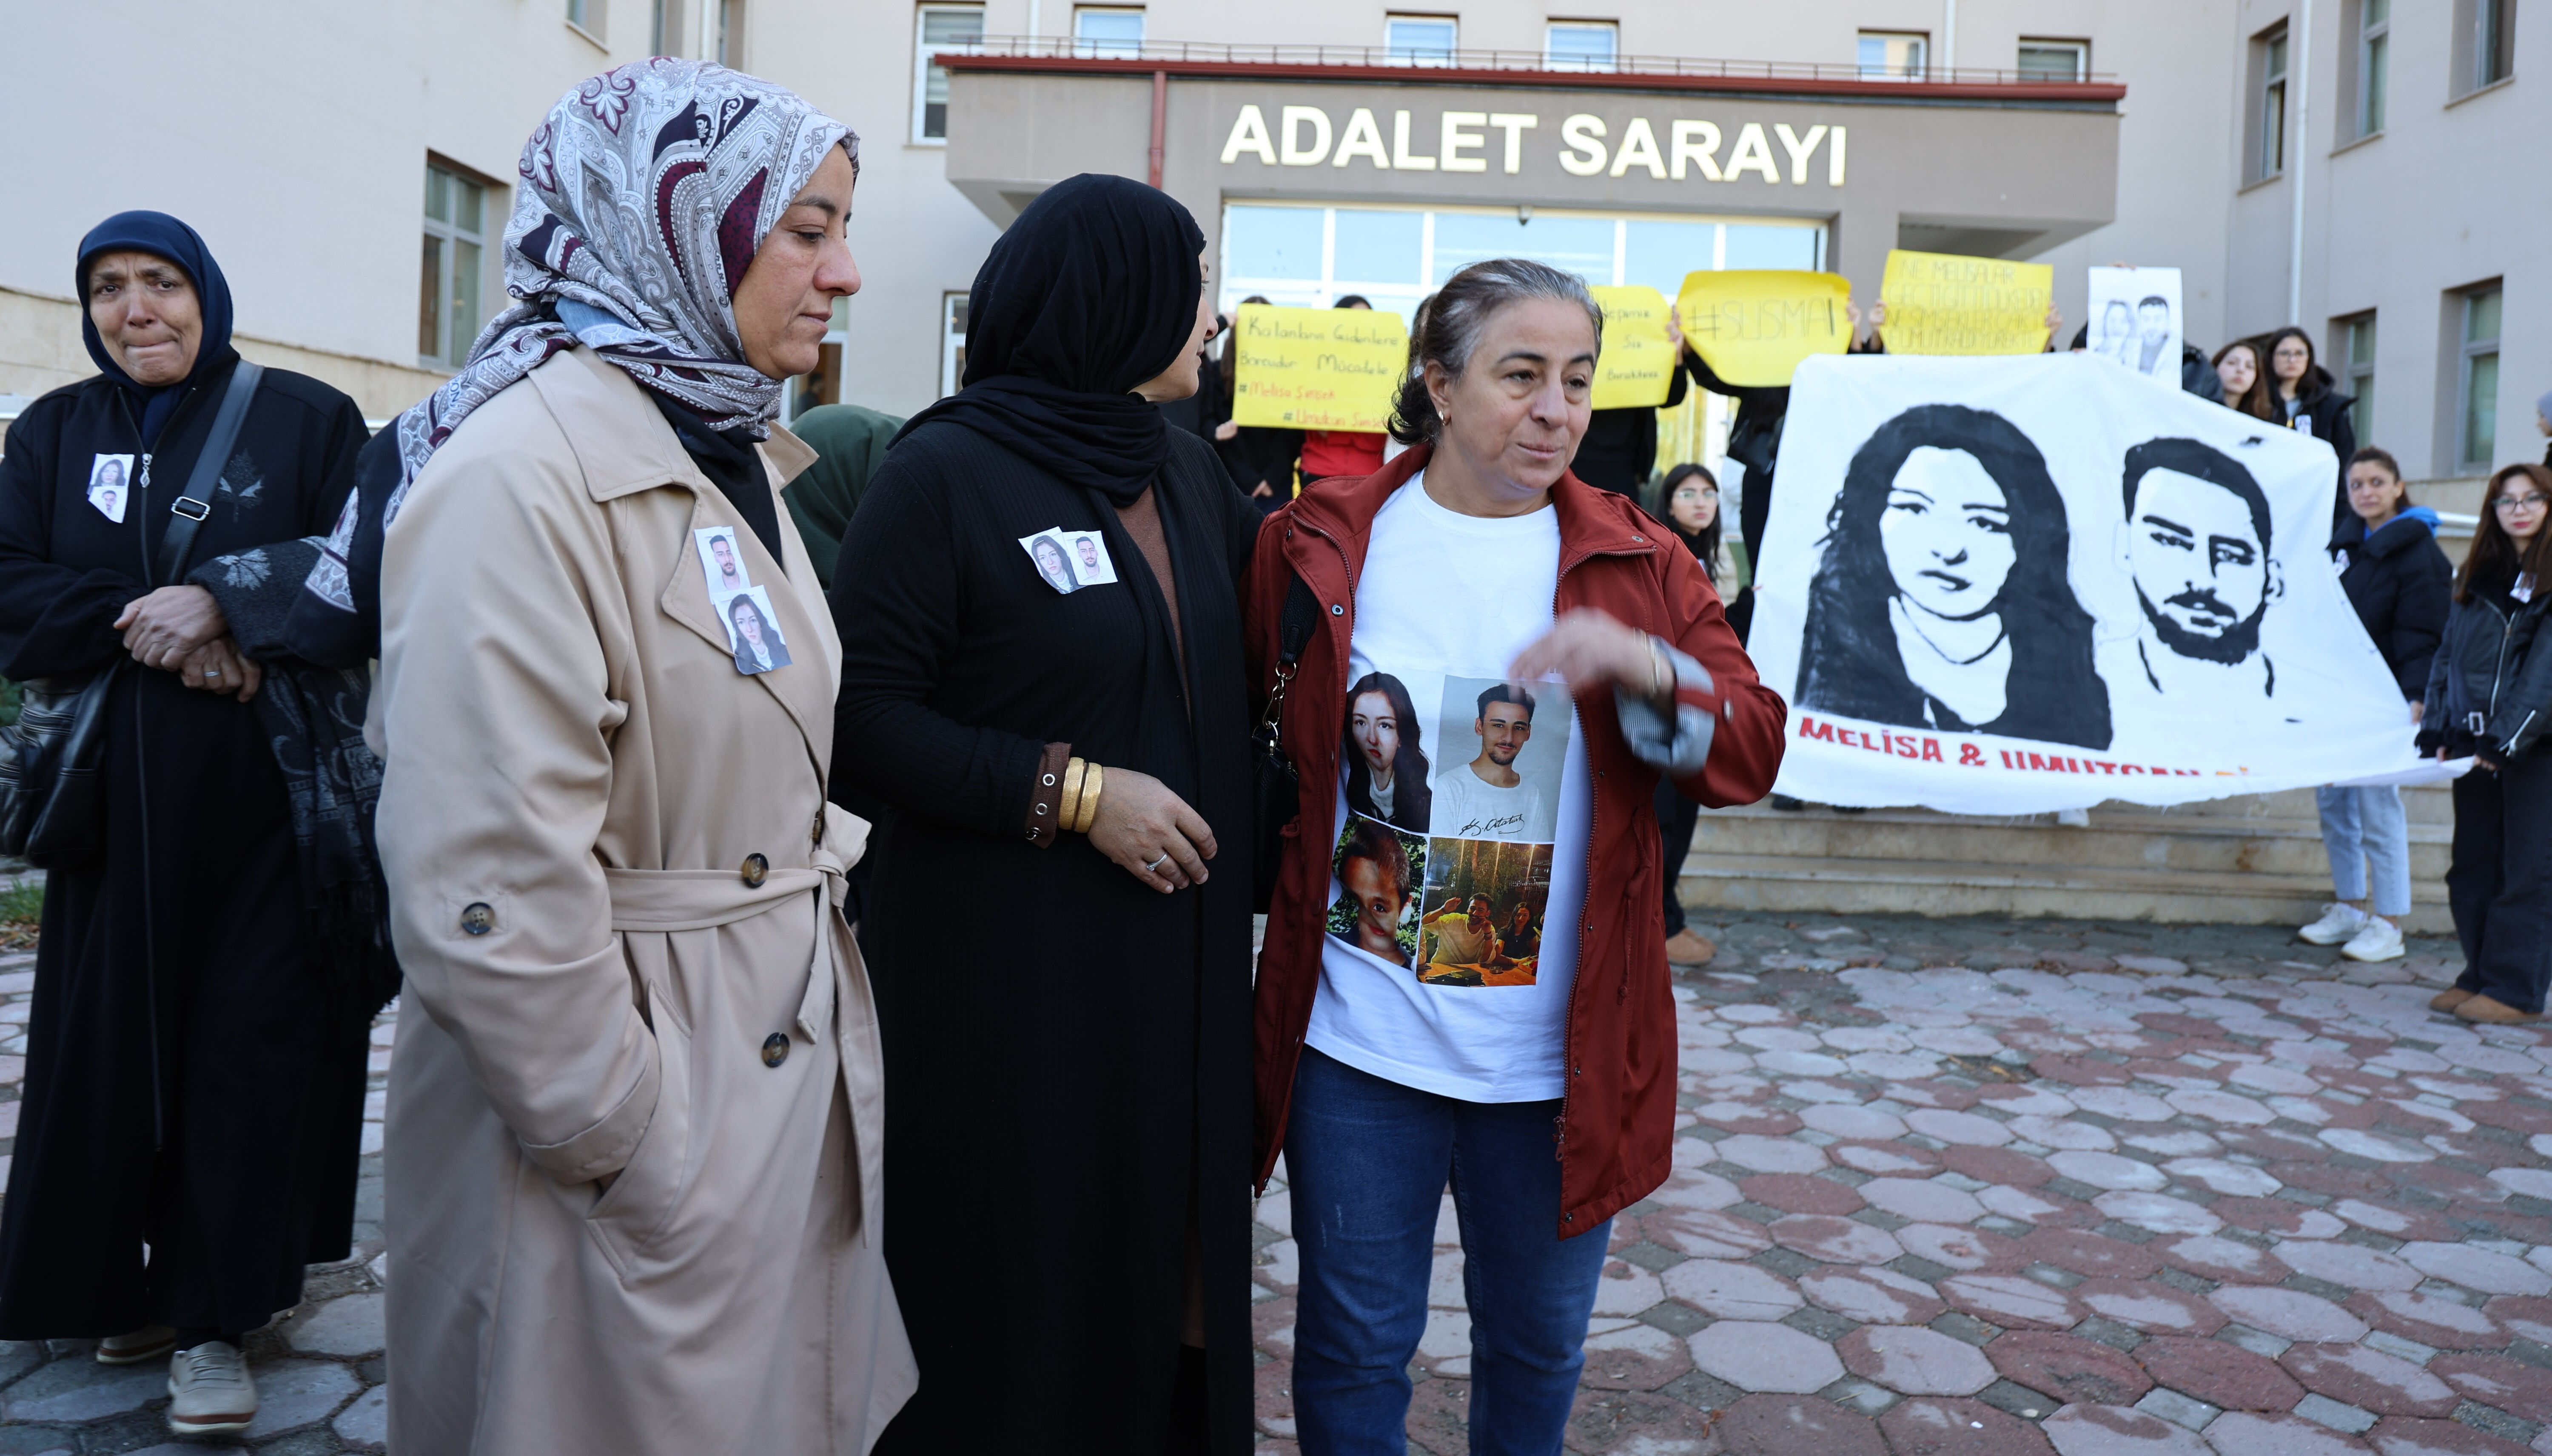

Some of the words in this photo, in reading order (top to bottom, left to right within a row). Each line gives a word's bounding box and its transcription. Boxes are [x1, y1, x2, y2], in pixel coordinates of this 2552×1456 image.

[1220, 105, 1538, 174] ADALET
[1558, 114, 1846, 186] SARAYI
[1800, 717, 1944, 763] MELİSA
[1959, 742, 1987, 766] &
